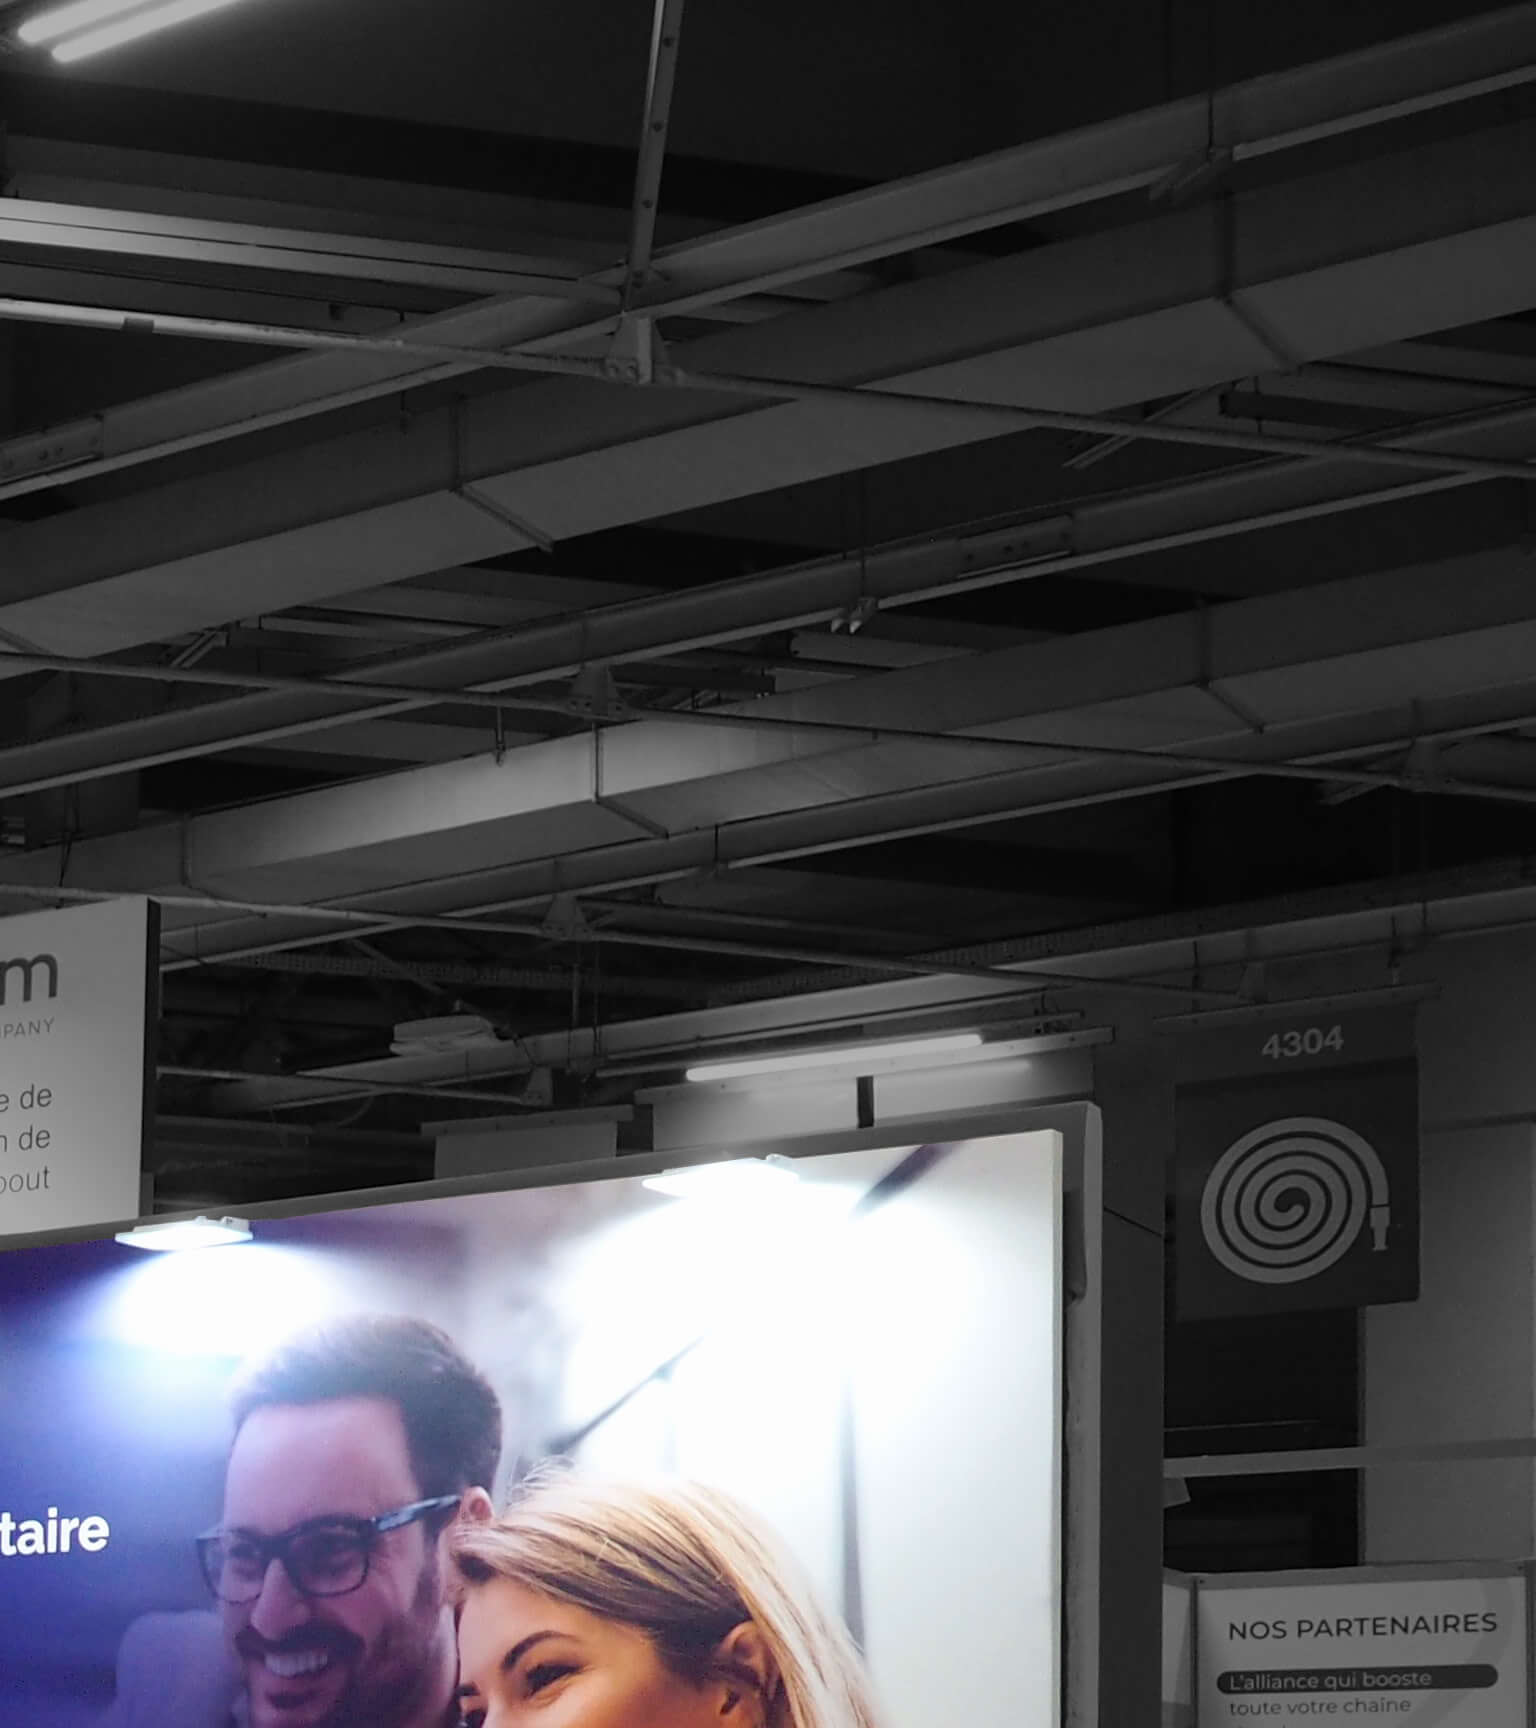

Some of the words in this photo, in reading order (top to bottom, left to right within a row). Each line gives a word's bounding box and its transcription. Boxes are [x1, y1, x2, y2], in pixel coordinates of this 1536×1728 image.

[1262, 1025, 1343, 1059] 4304
[20, 1084, 53, 1109] de
[18, 1126, 51, 1150] de
[1228, 1620, 1288, 1640] NOS
[1297, 1613, 1497, 1638] PARTENAIRES
[1230, 1673, 1318, 1690] L'alliance
[1324, 1671, 1356, 1691] qui
[1363, 1670, 1432, 1688] booste
[1230, 1700, 1281, 1716] toute
[1286, 1699, 1338, 1714] votre
